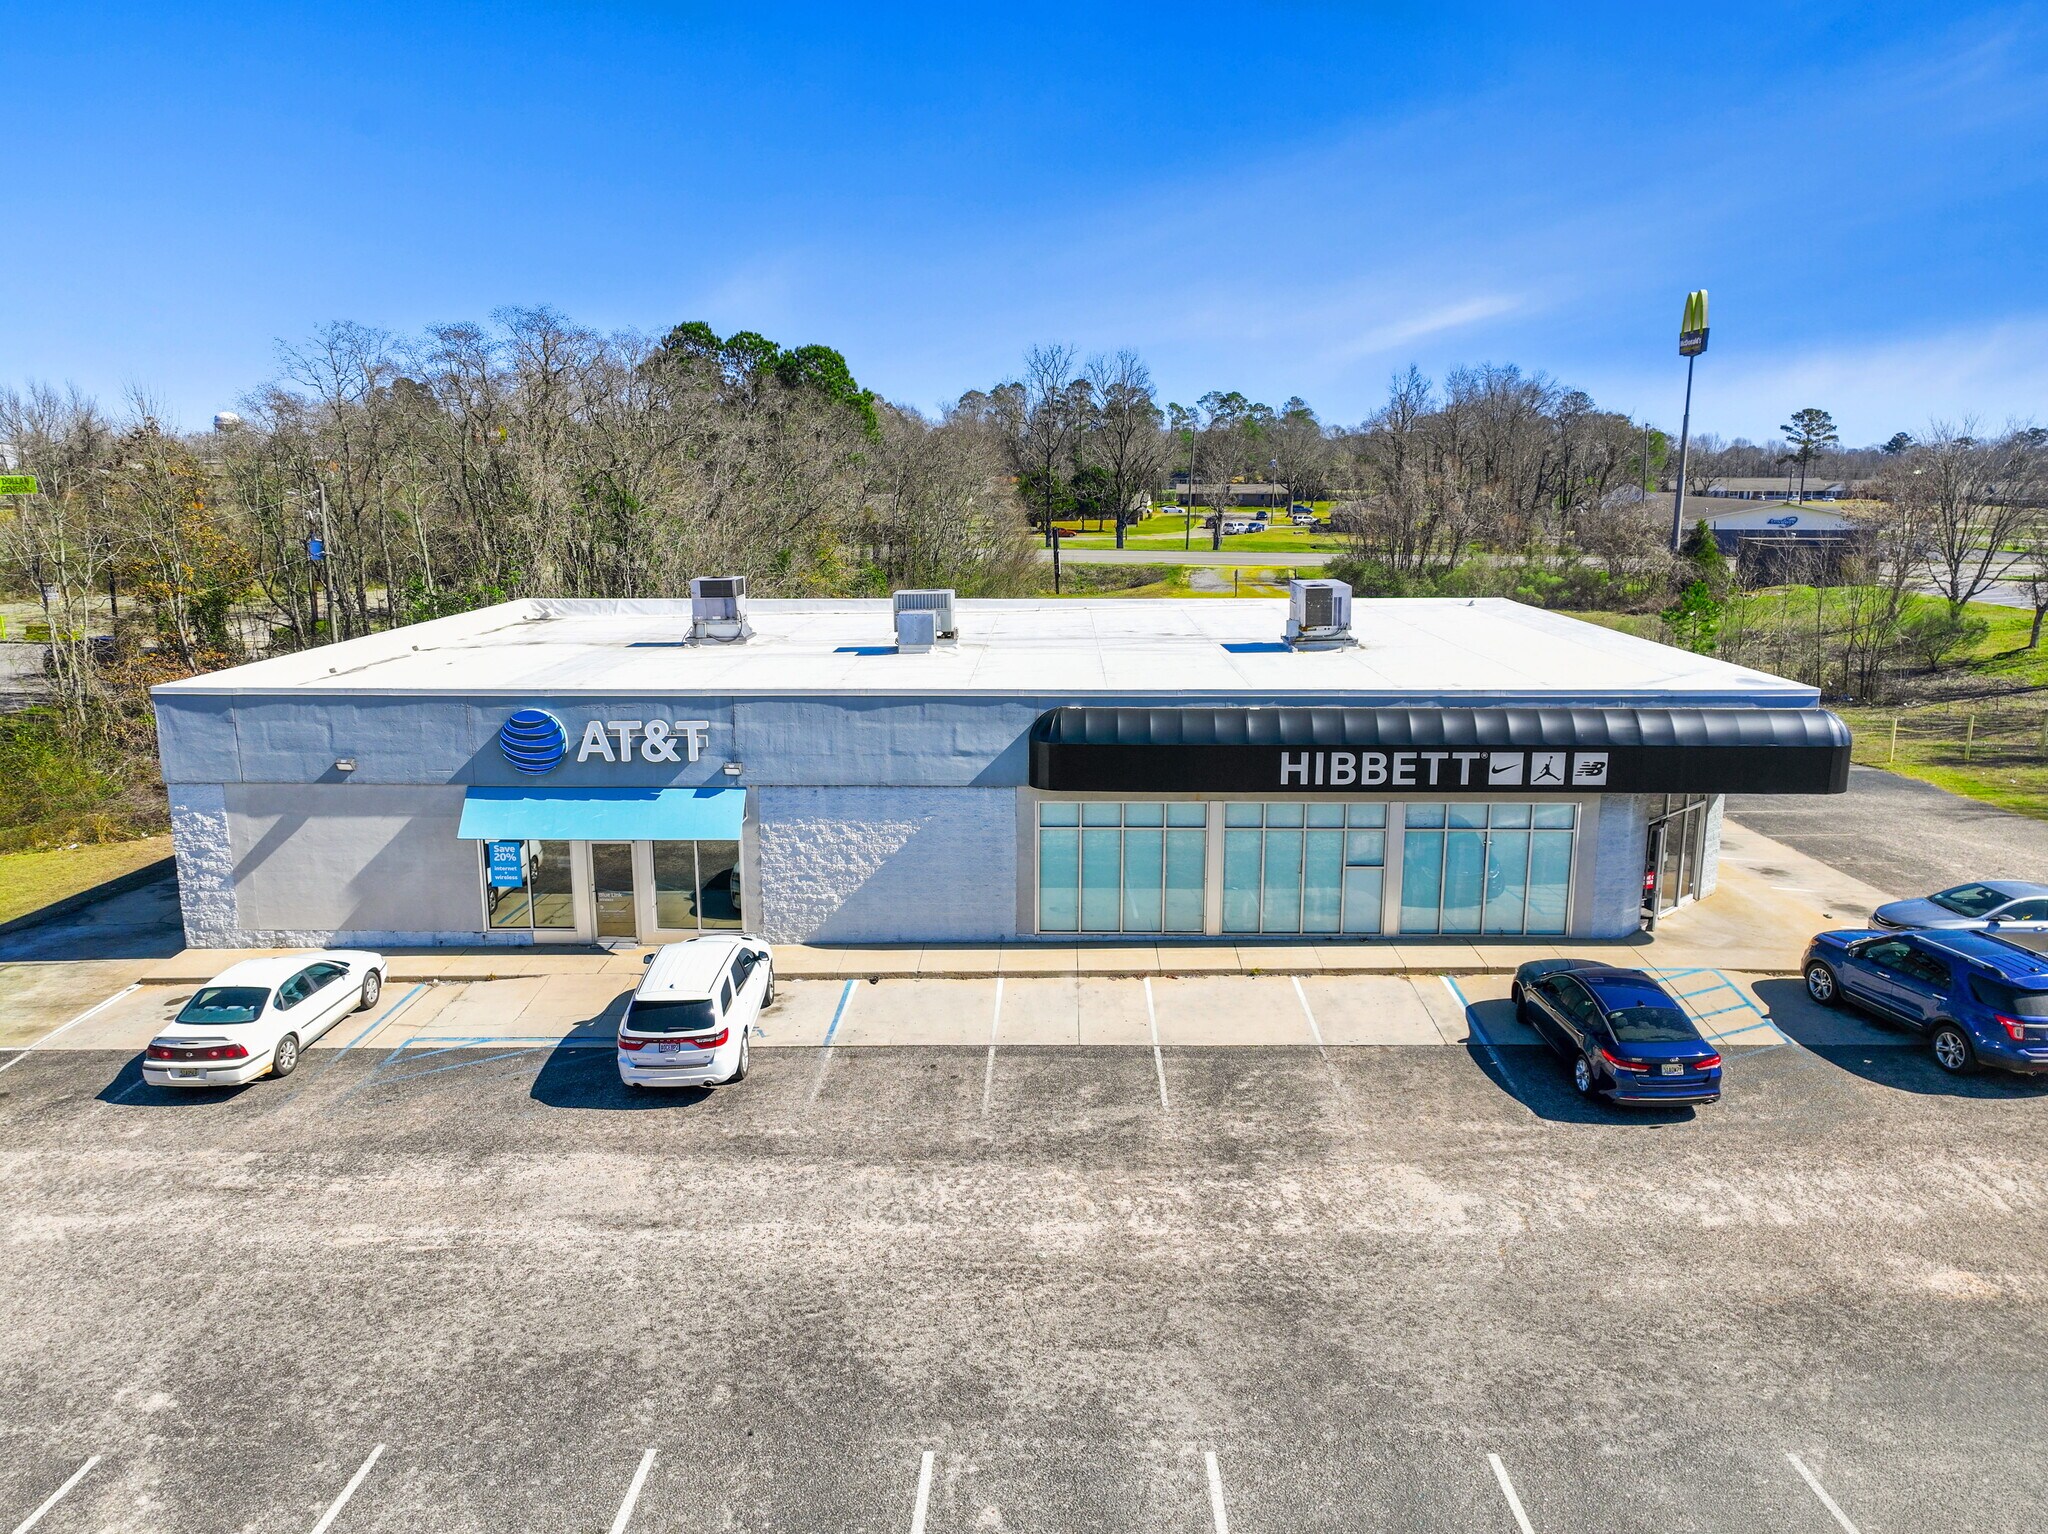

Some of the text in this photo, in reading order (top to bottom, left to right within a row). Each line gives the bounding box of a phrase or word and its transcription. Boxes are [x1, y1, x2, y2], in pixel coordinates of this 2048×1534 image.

[577, 719, 709, 763] AT&T
[493, 845, 515, 853] Save
[494, 853, 516, 862] 20%
